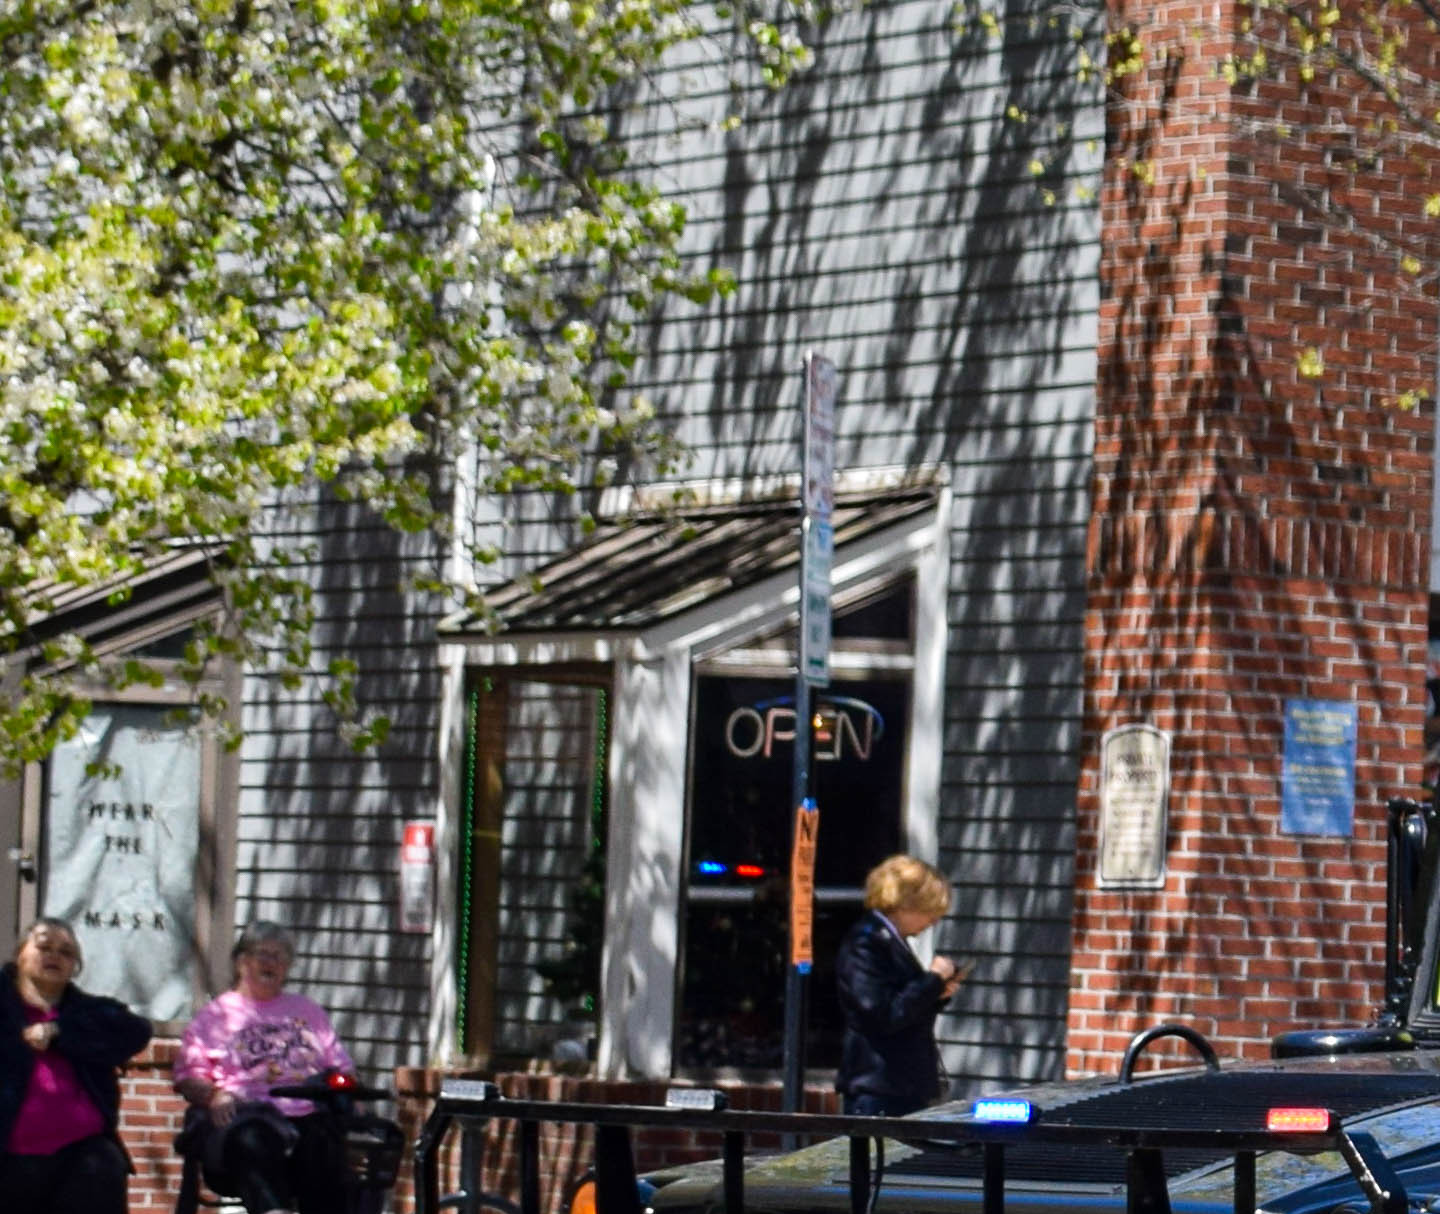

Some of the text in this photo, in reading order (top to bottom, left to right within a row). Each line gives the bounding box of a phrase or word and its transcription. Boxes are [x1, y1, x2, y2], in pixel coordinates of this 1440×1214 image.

[725, 706, 873, 761] OPEN
[104, 833, 142, 854] THE
[84, 910, 165, 931] MASK
